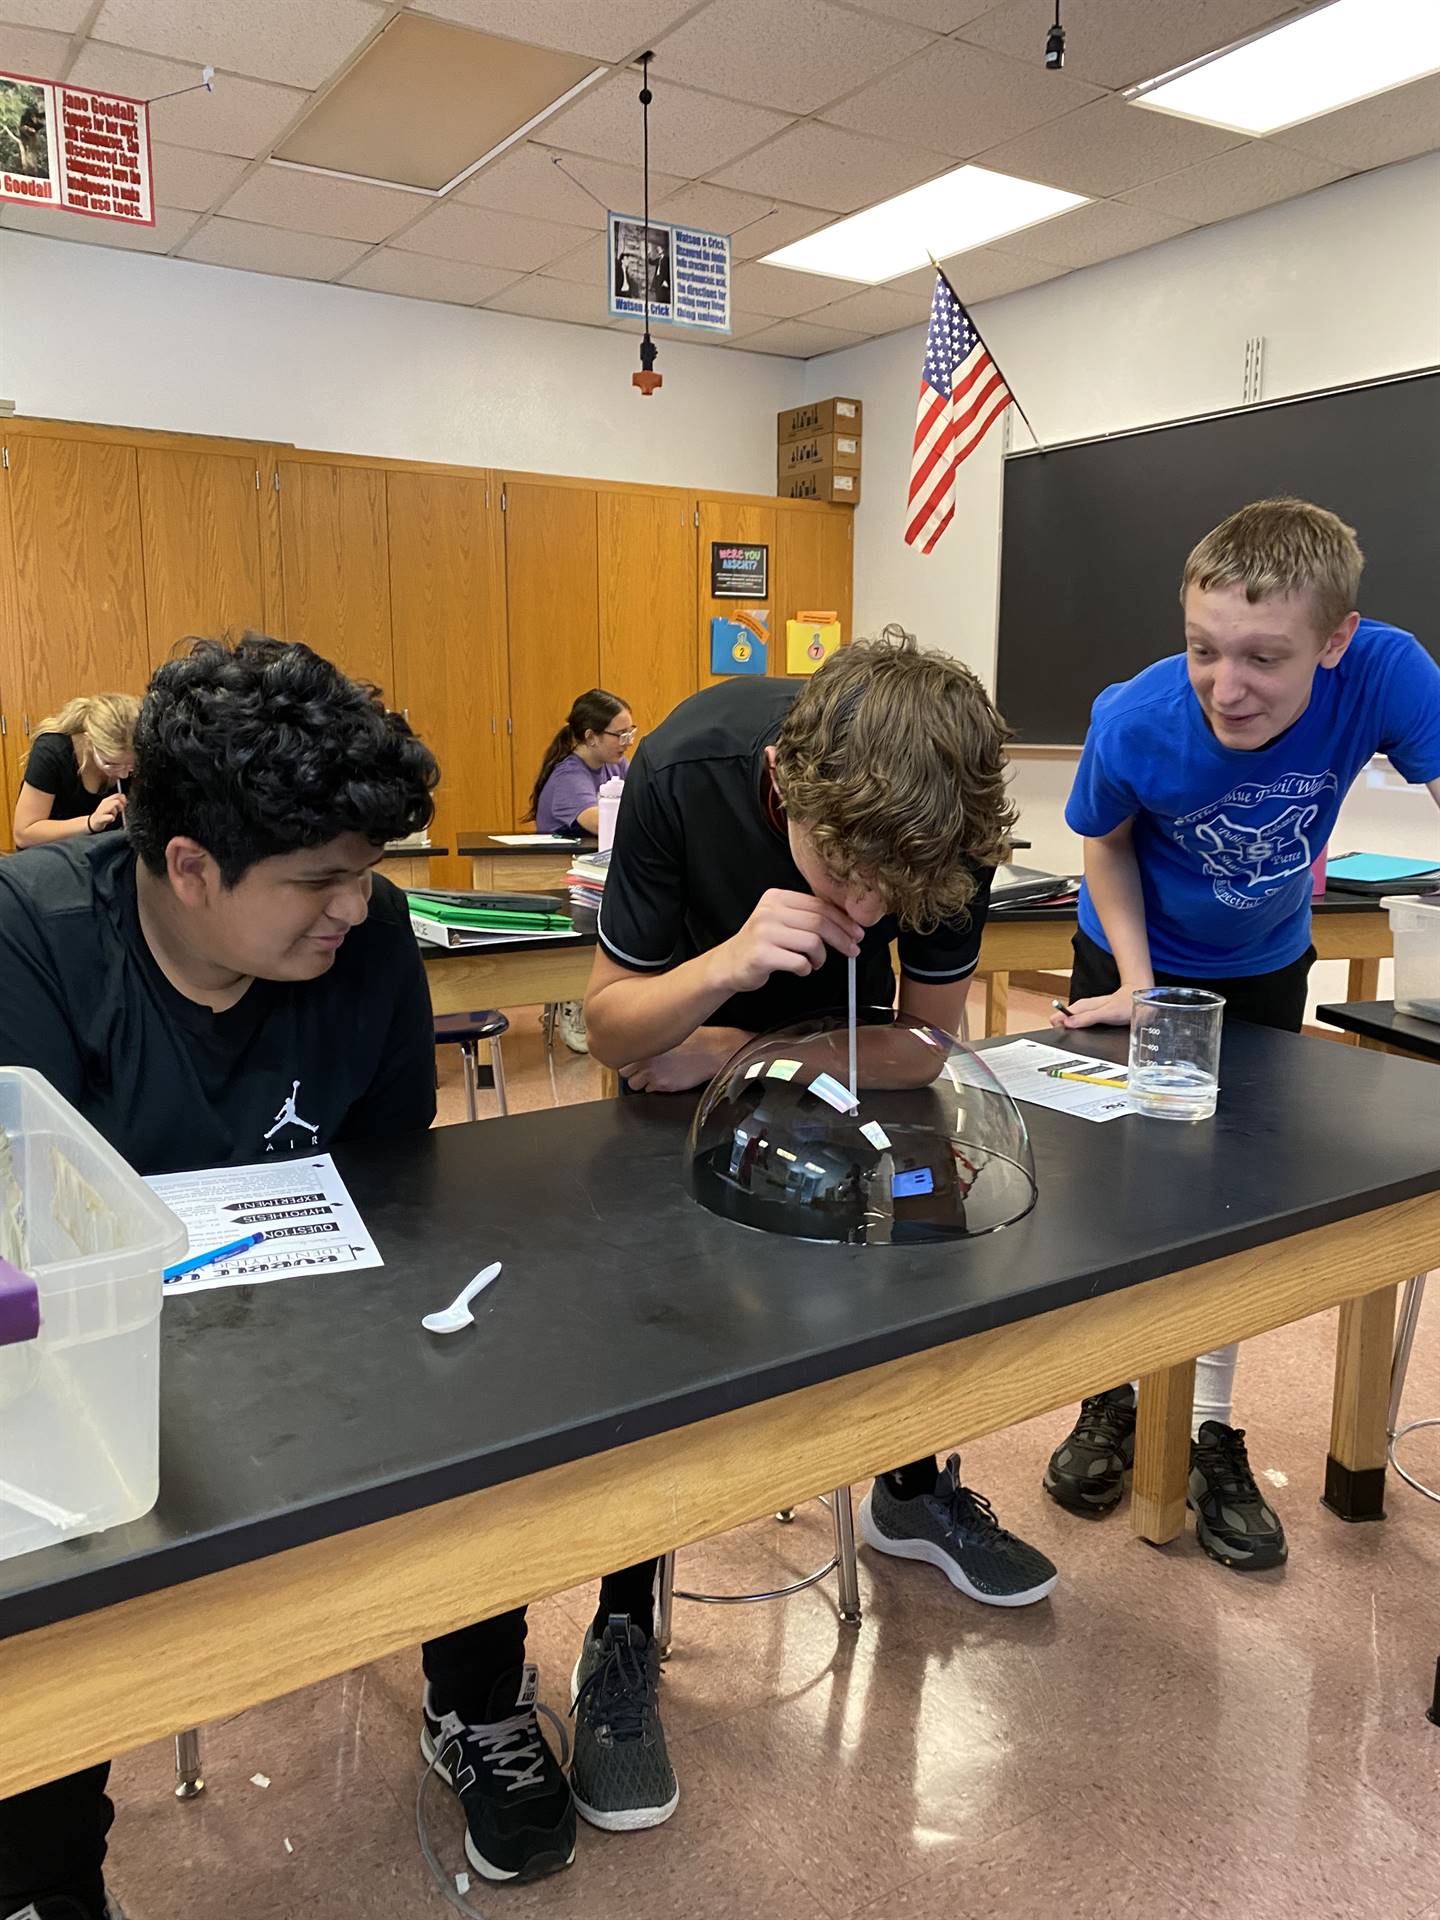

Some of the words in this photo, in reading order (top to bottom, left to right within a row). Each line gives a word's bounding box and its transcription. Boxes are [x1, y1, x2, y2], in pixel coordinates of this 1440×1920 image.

[63, 90, 88, 112] Jane
[91, 97, 138, 122] Goodall:
[65, 141, 118, 164] discovered
[119, 151, 138, 169] that
[3, 174, 52, 198] Goodall
[68, 193, 89, 208] and
[91, 197, 111, 212] use
[112, 200, 143, 218] tools.
[675, 230, 701, 246] Watson
[702, 237, 708, 247] &
[687, 284, 717, 299] directions
[615, 298, 643, 313] Watson
[650, 303, 670, 316] Crick
[696, 299, 710, 310] every
[677, 307, 696, 321] thing
[719, 549, 744, 560] WERE
[744, 551, 761, 561] YOU
[722, 559, 757, 570] ABSENT?
[739, 647, 745, 657] 2
[813, 647, 820, 657] 7
[1224, 789, 1252, 803] Blue
[1148, 1027, 1160, 1036] 500
[1147, 1044, 1159, 1052] 400
[266, 1135, 318, 1152] AIR
[238, 1193, 319, 1211] EXPERIMENT
[243, 1206, 325, 1224] HYPOTHESIS
[263, 1223, 334, 1240] QUESTION
